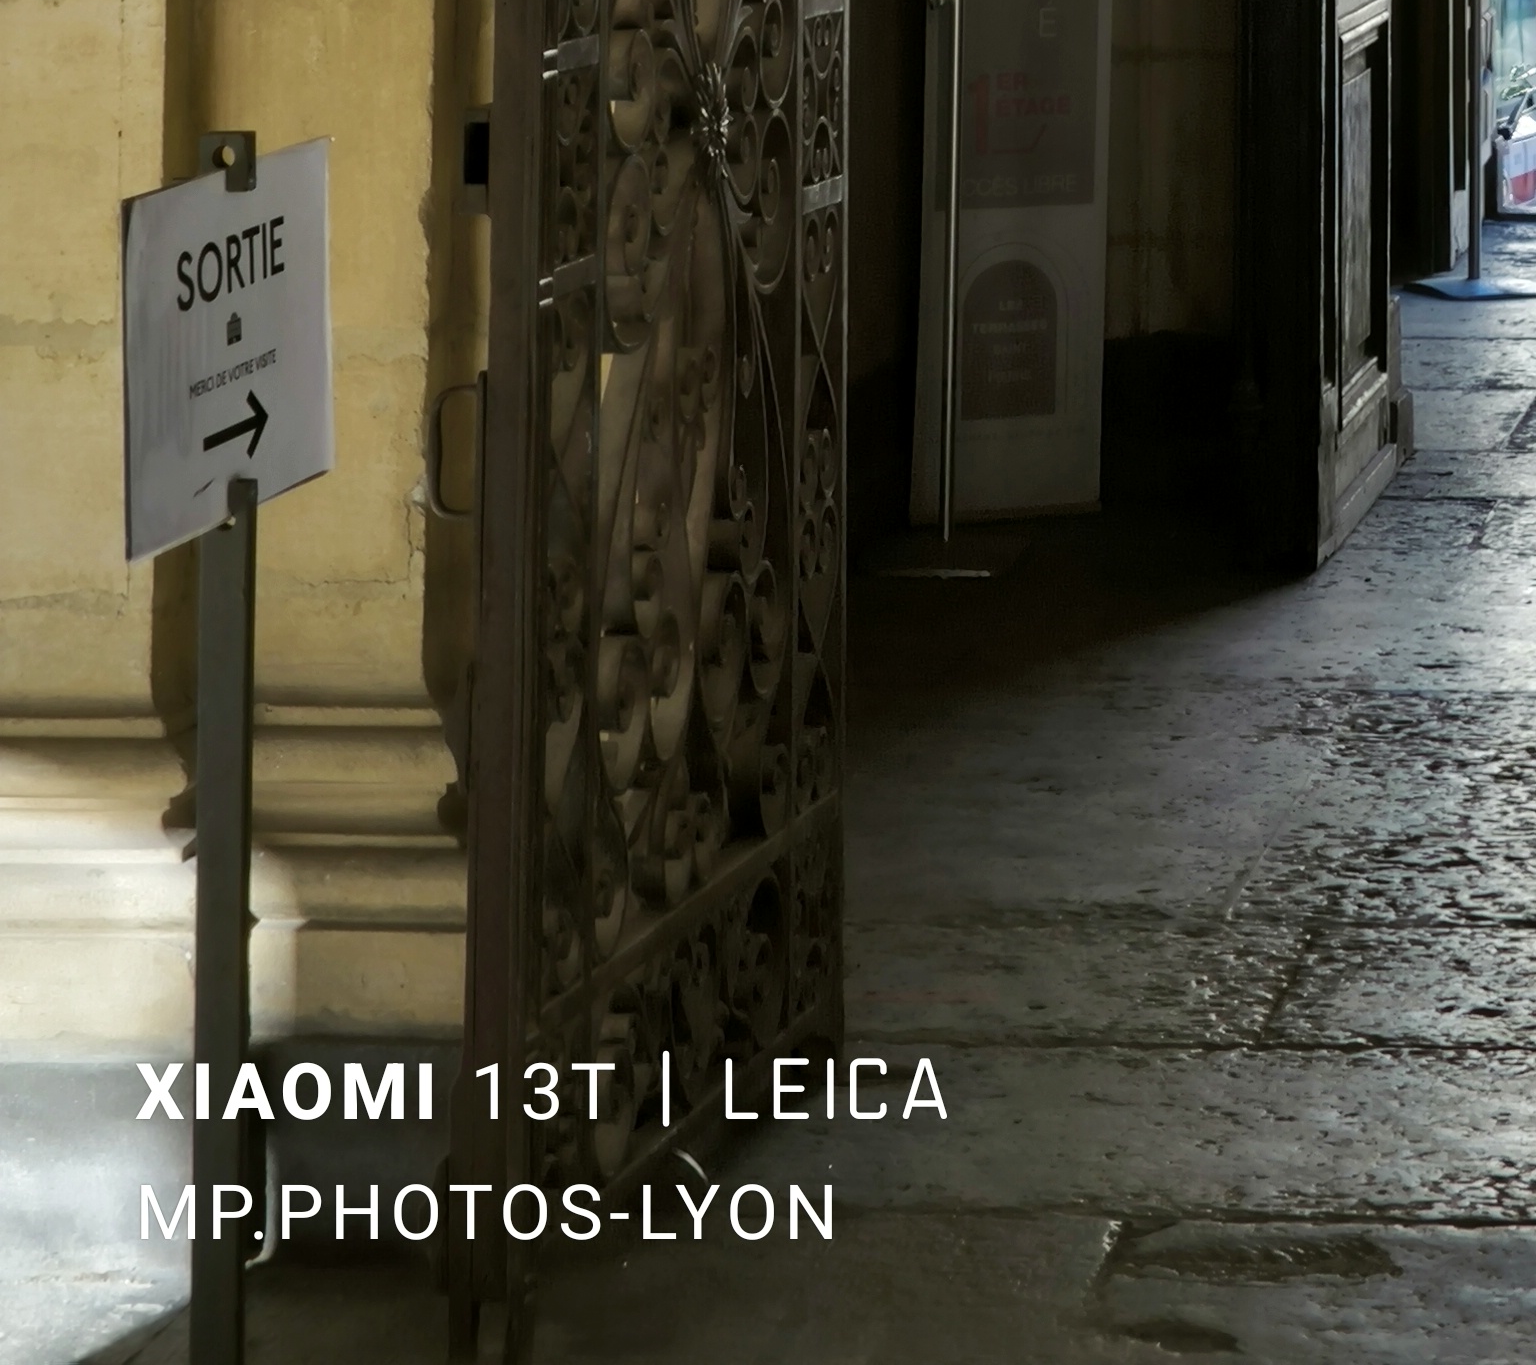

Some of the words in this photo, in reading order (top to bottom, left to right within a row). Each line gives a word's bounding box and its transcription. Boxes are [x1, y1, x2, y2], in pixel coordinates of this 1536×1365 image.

[962, 174, 1018, 197] CCÈS
[1022, 173, 1078, 194] LIBRE
[177, 216, 285, 312] SORTIE
[189, 375, 214, 400] MERCI
[216, 370, 227, 389] DE
[229, 359, 254, 382] VOTRE
[255, 348, 277, 370] VISITE
